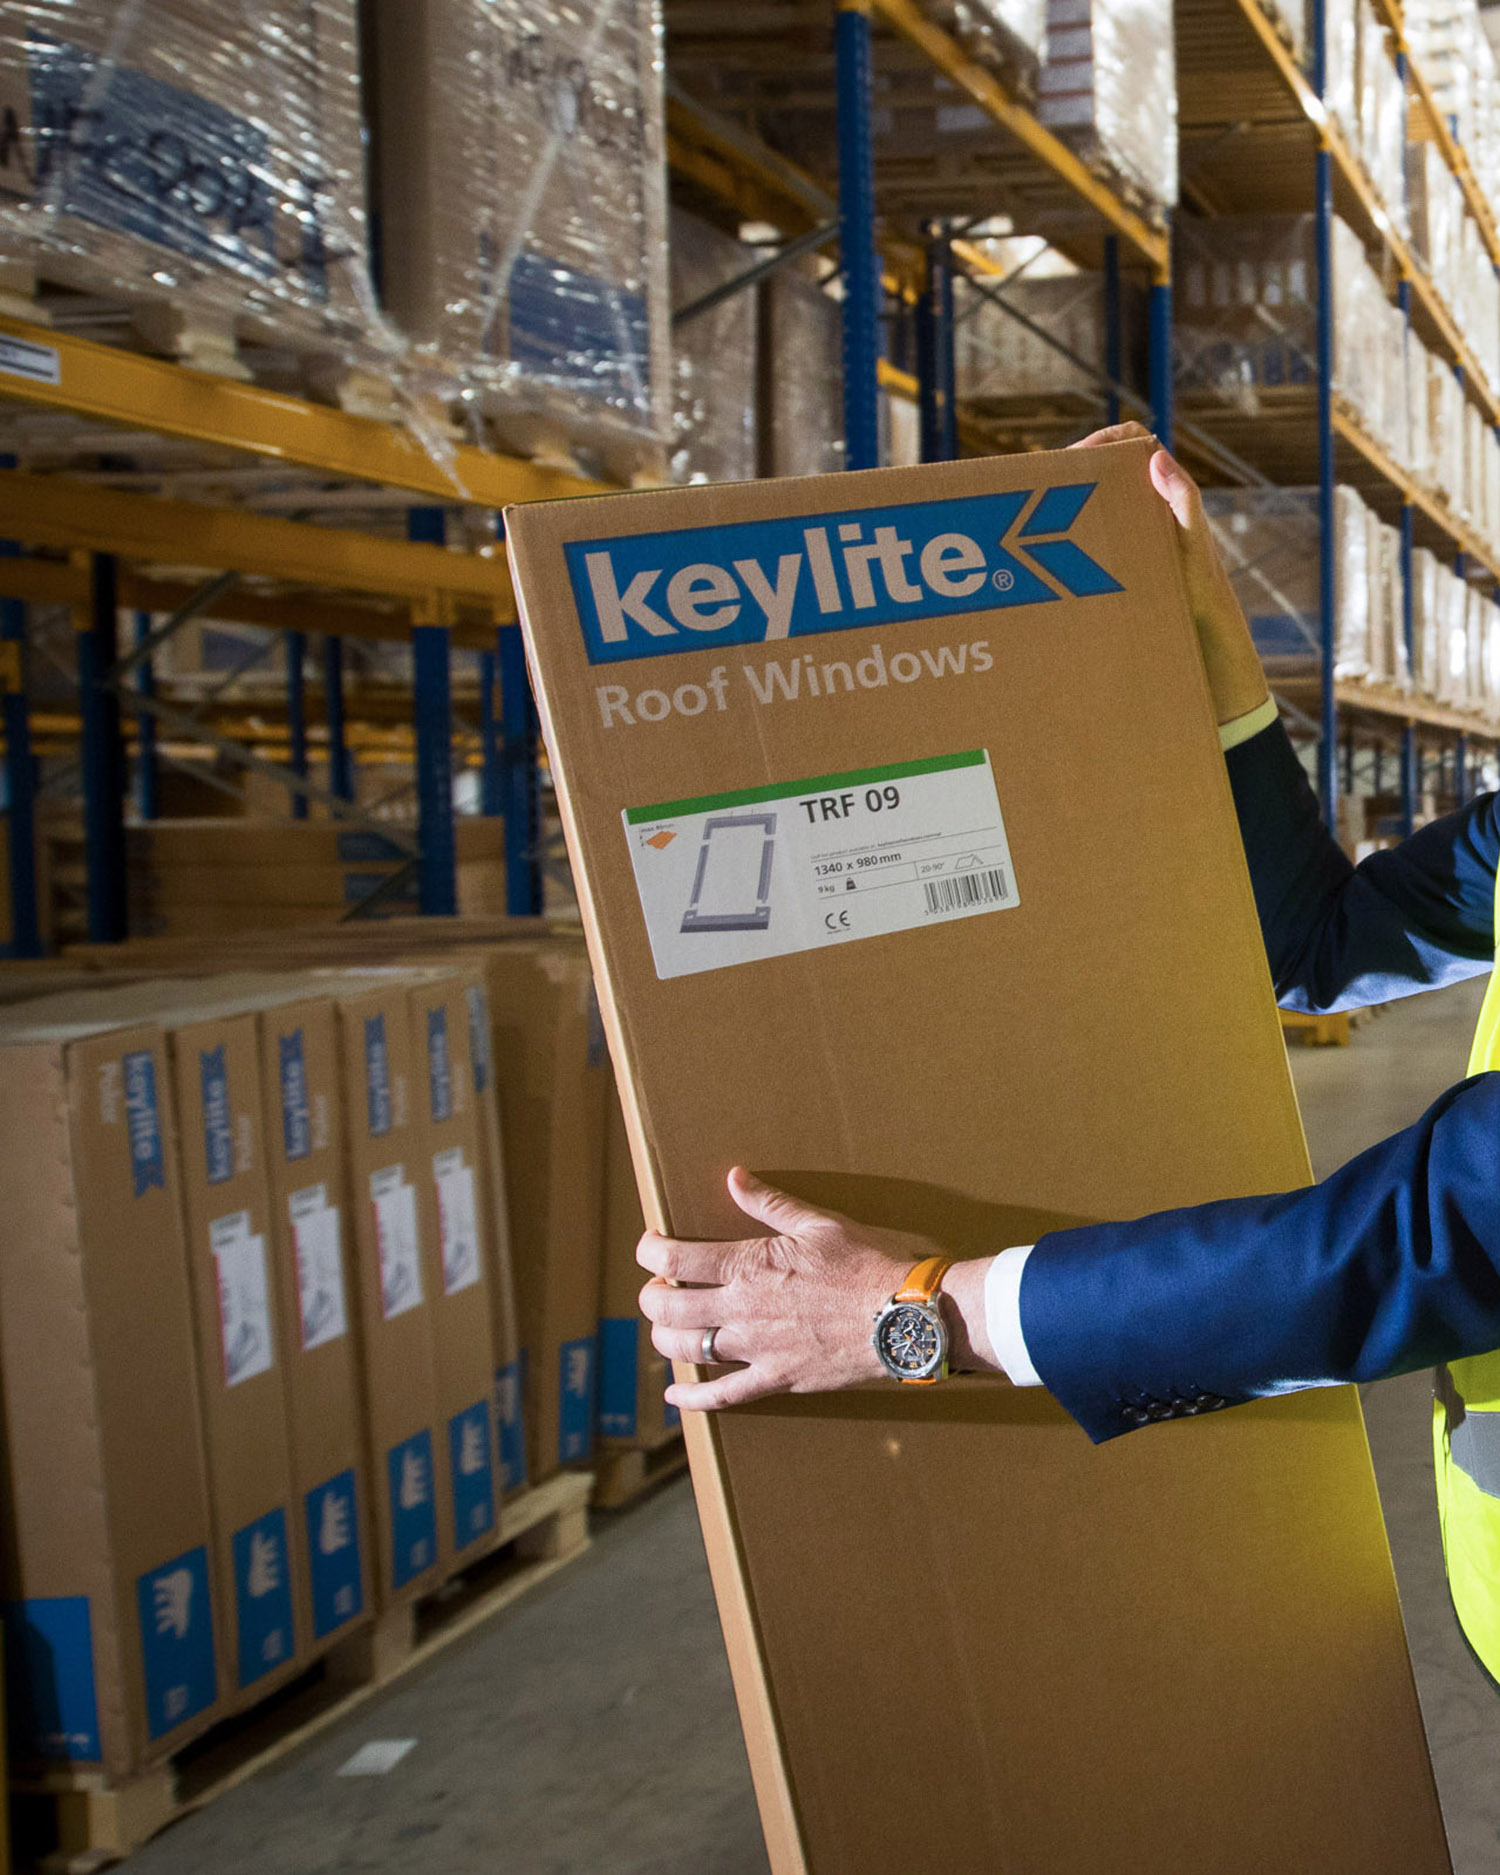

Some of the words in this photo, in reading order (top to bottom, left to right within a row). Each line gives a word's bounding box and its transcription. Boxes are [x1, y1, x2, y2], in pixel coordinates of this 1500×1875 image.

[596, 665, 729, 729] Roof
[744, 640, 994, 706] Windows
[800, 793, 855, 824] TRF
[865, 785, 901, 813] 09
[815, 862, 843, 876] 1340
[846, 863, 854, 871] x
[126, 1054, 156, 1161] keylite
